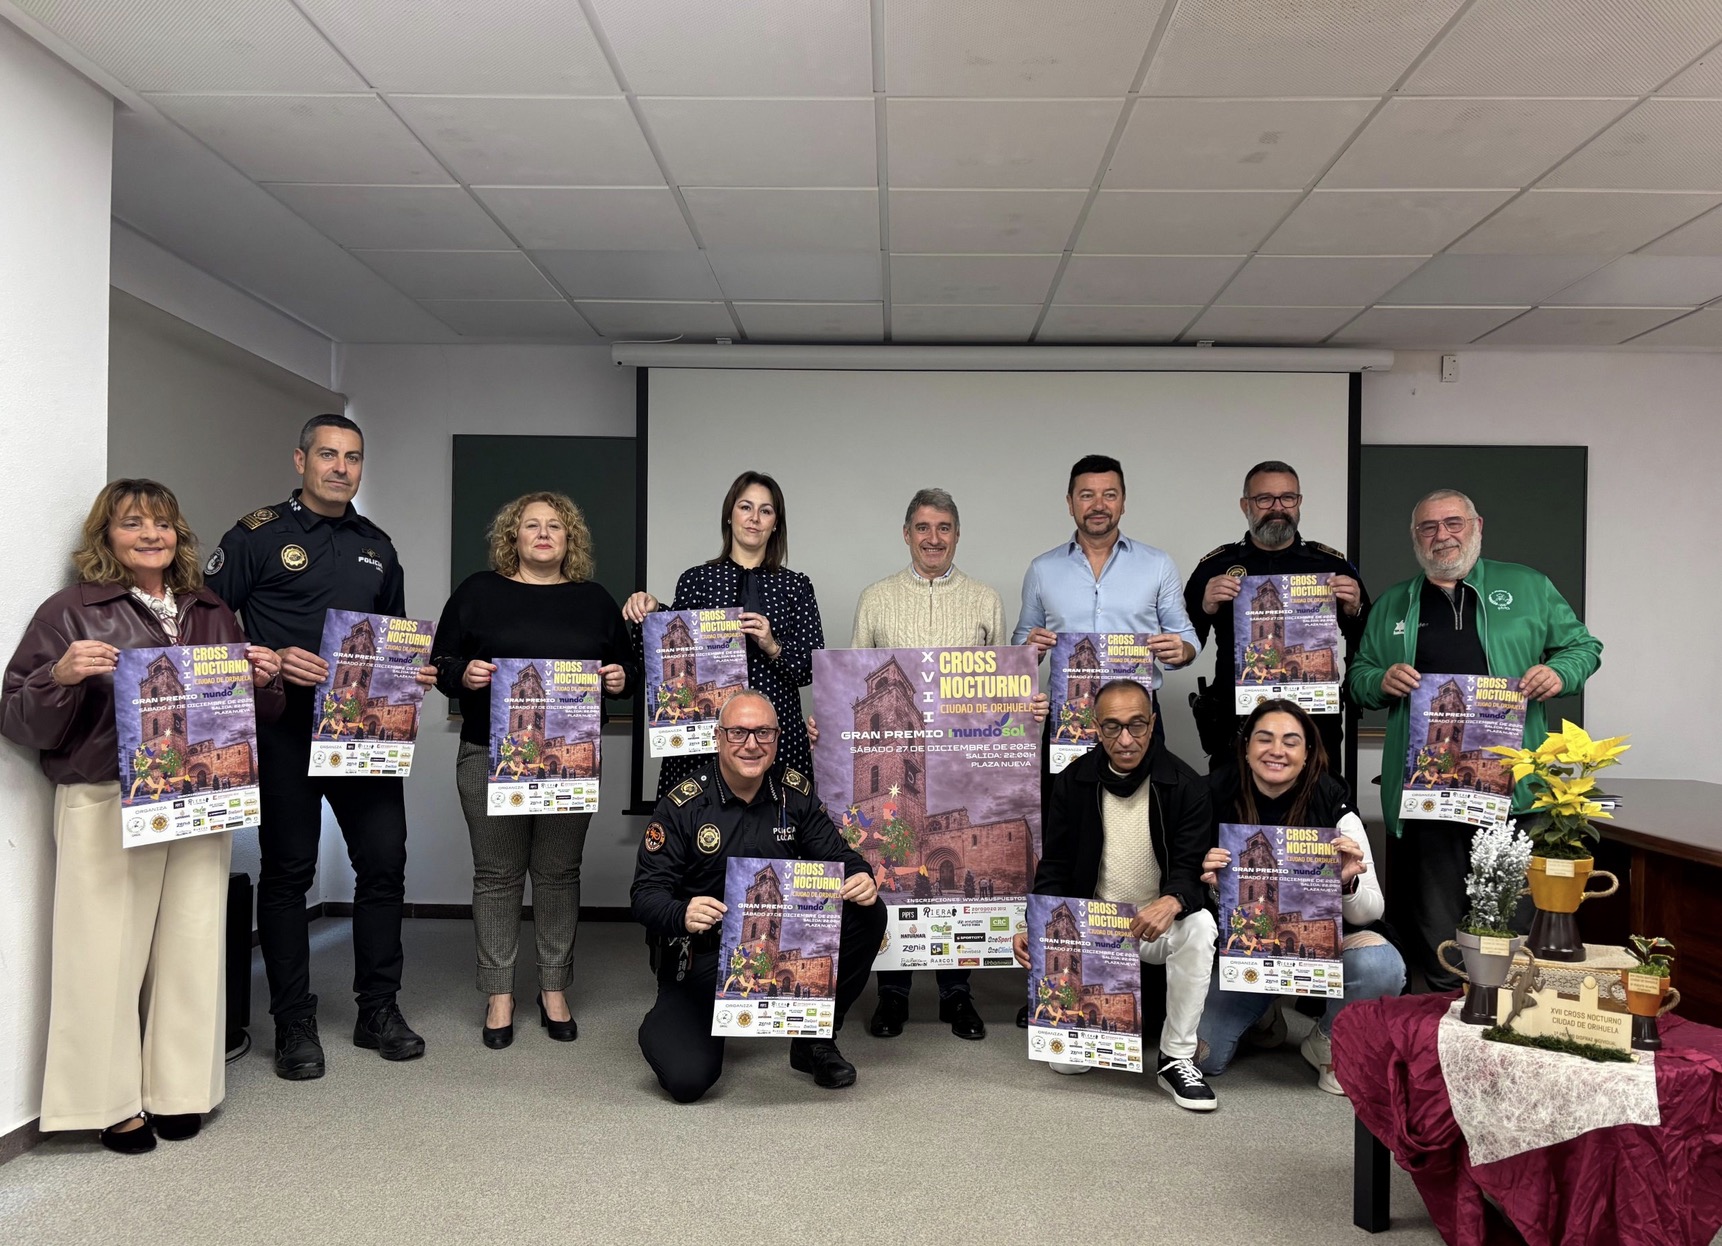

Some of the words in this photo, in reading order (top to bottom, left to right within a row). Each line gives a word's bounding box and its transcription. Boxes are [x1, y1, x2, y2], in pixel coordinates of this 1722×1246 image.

[1290, 576, 1316, 586] CROSS
[1291, 586, 1333, 596] NOCTURNO
[700, 610, 725, 621] CROSS
[389, 619, 418, 632] CROSS
[387, 631, 432, 646] NOCTURNO
[1108, 635, 1134, 645] CROSS
[193, 647, 228, 661] CROSS
[194, 660, 249, 676] NOCTURNO
[554, 662, 582, 672] CROSS
[940, 651, 996, 673] CROSS
[554, 674, 598, 684] NOCTURNO
[1477, 678, 1507, 689] CROSS
[940, 675, 1031, 698] NOCTURNO
[161, 694, 197, 702] PREMIO
[1476, 690, 1524, 702] NOCTURNO
[940, 704, 974, 714] CIUDAD
[976, 703, 987, 713] DE
[991, 703, 1034, 712] ORIHUELA
[841, 731, 881, 740] GRAN
[885, 729, 943, 739] PREMIO
[850, 745, 893, 753] SÁBADO
[1286, 829, 1318, 841] CROSS
[794, 863, 824, 876] CROSS
[793, 876, 841, 890] NOCTURNO
[1088, 902, 1117, 915] CROSS
[1089, 915, 1133, 929] NOCTURN
[1564, 1010, 1585, 1019] CROSS
[1587, 1014, 1622, 1025] NOCTURNO
[1552, 1017, 1575, 1026] CIUDAD
[1587, 1023, 1619, 1034] ORIHUELA
